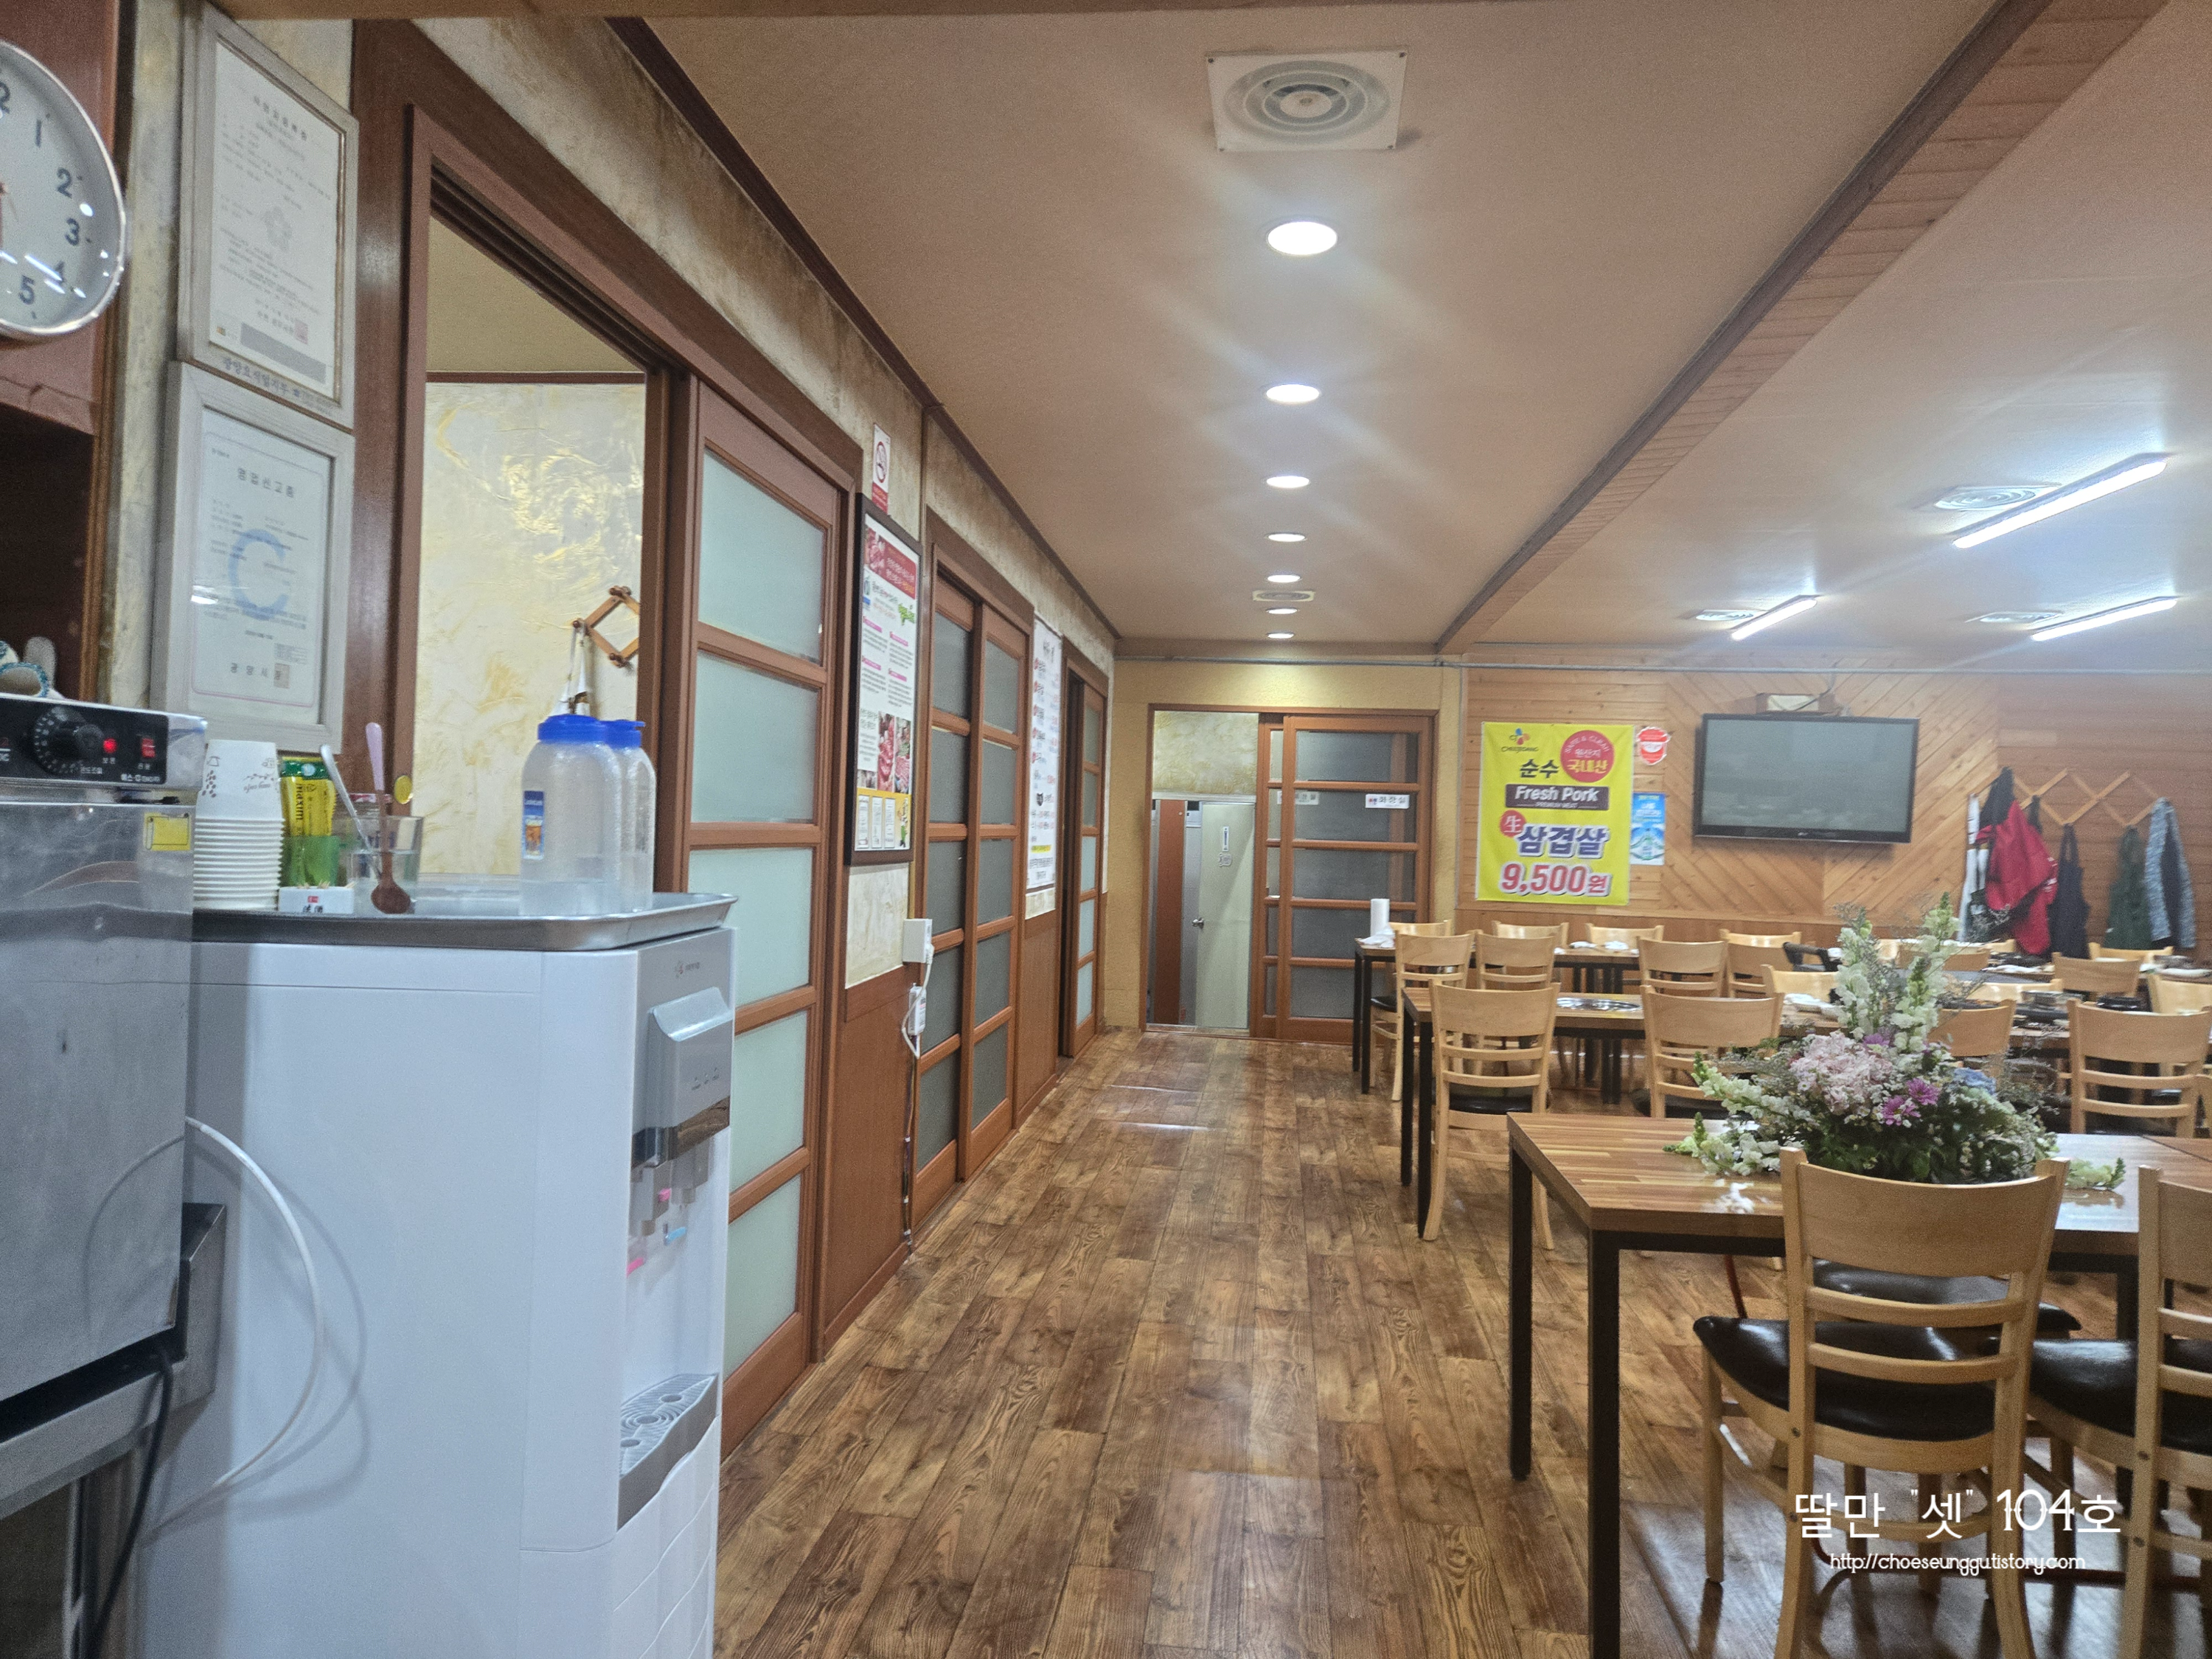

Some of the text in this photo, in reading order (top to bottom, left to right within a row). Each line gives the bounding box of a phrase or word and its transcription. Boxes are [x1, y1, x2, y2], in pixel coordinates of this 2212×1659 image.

[0, 82, 10, 114] 2
[35, 119, 42, 147] 1
[57, 167, 73, 199] 2
[65, 218, 80, 247] 3
[18, 274, 35, 305] 5
[1519, 758, 1559, 779] 순수
[1566, 759, 1608, 774] 국내산
[1514, 785, 1600, 802] Fresh Pork
[1503, 815, 1523, 833] 生
[1516, 824, 1609, 858] 삼겹살
[1500, 862, 1610, 894] 9,500원
